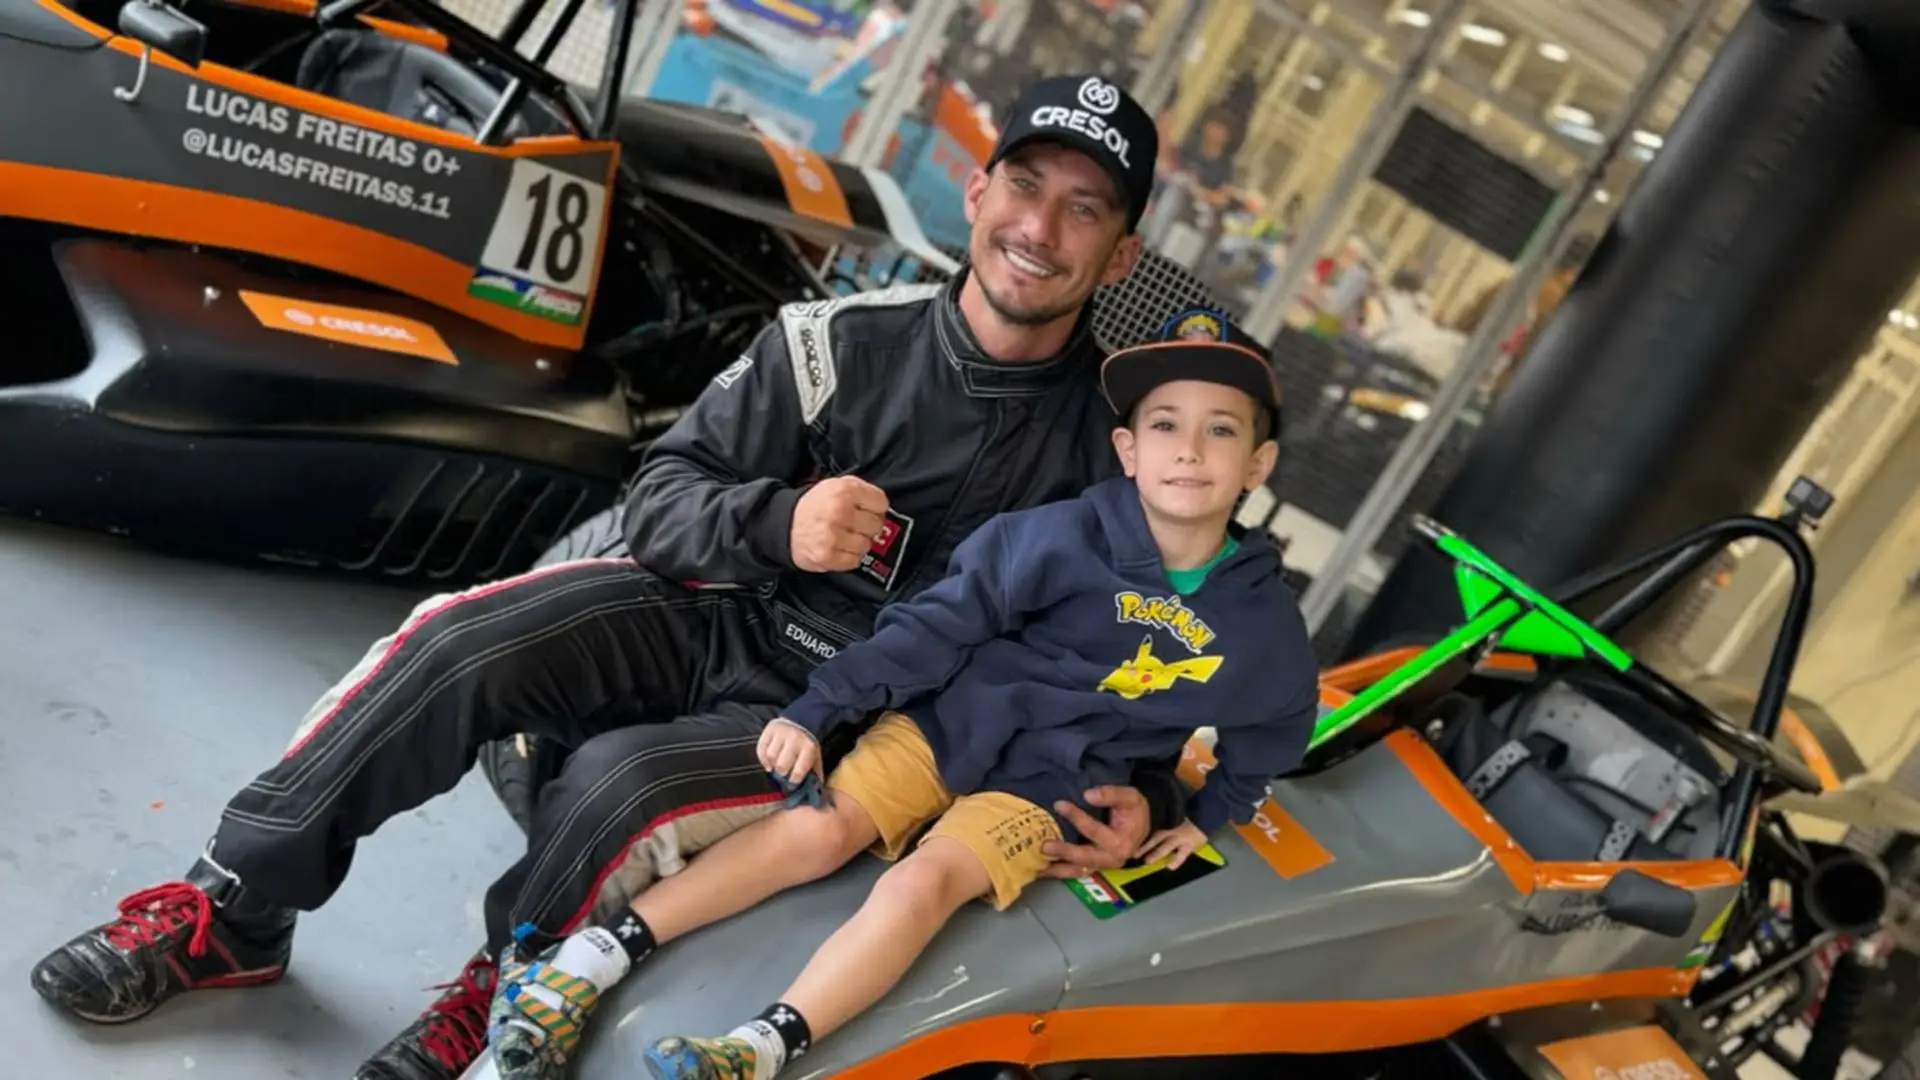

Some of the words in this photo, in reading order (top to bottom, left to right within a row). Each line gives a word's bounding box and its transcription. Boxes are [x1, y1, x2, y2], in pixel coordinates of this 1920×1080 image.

[186, 84, 290, 133] LUCAS
[296, 113, 418, 167] FREITAS
[1031, 106, 1130, 169] CRESOL
[183, 127, 451, 218] @LUCASFREITASS.11
[514, 173, 589, 283] 18
[785, 623, 840, 660] EDUARD
